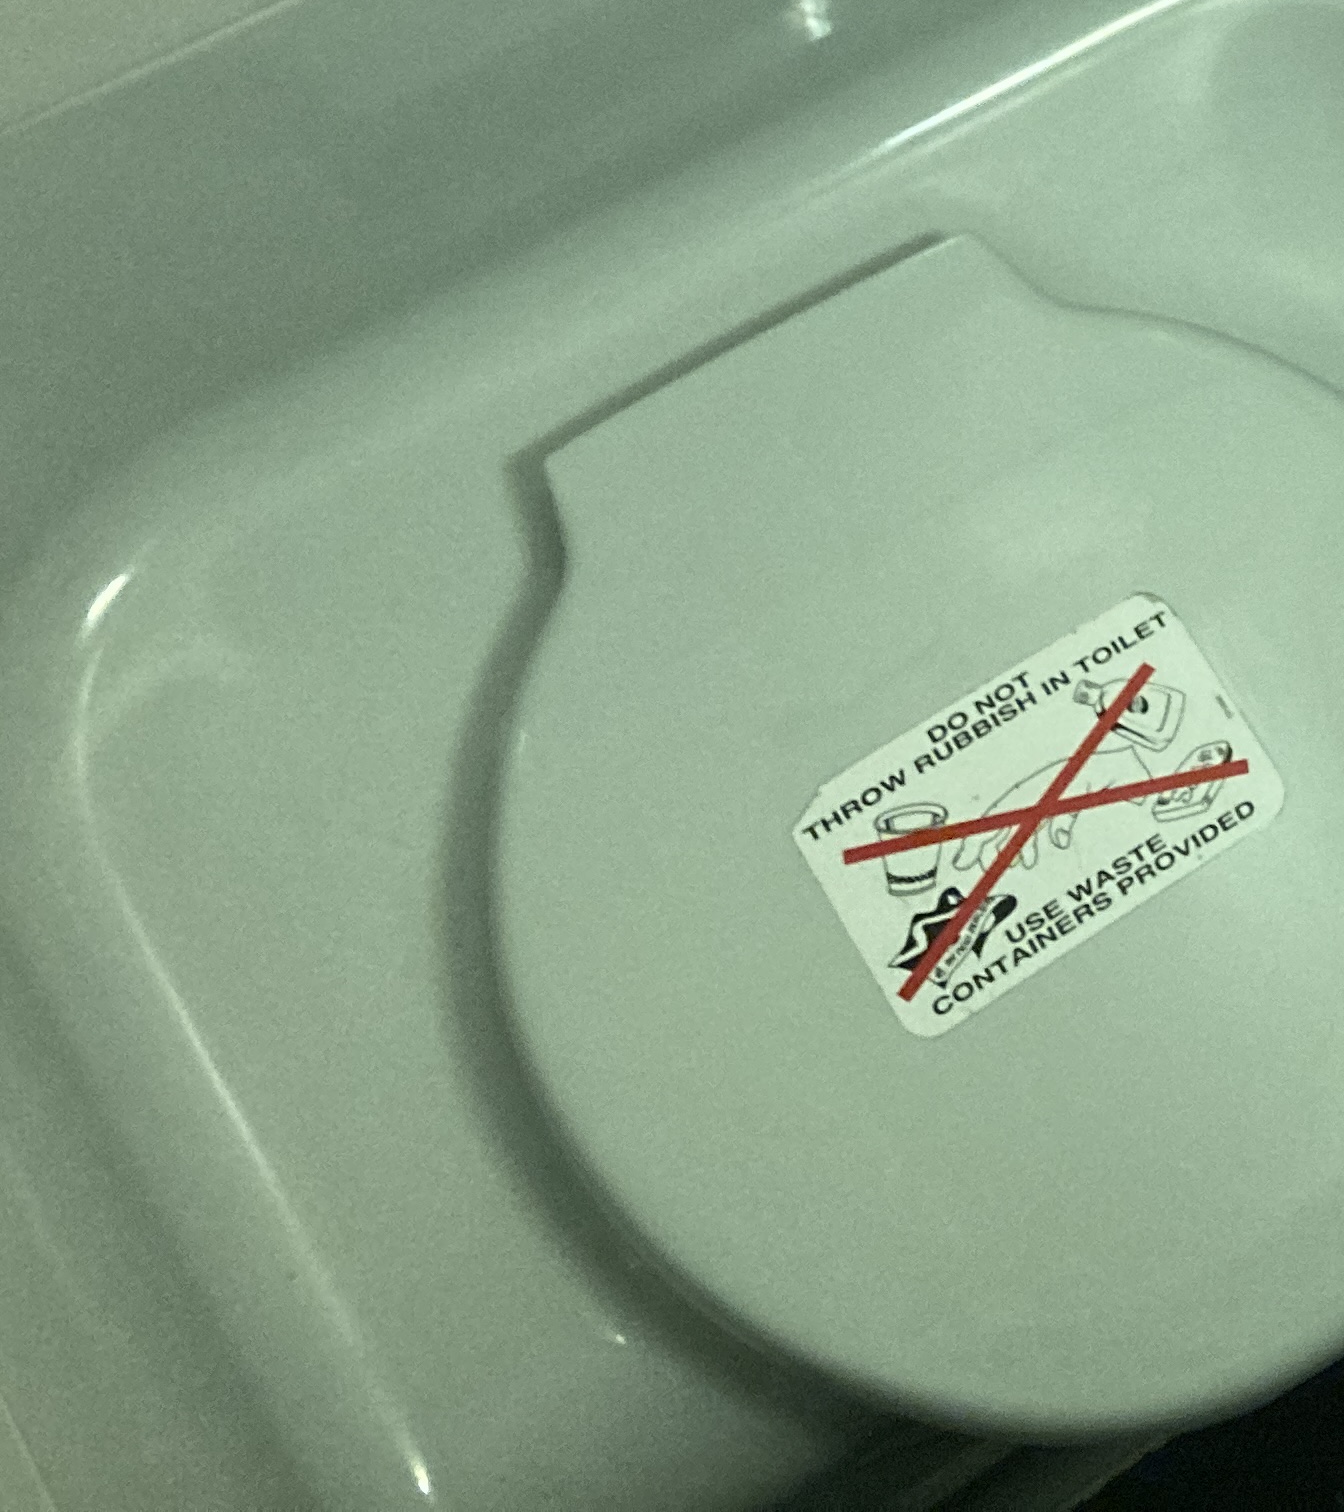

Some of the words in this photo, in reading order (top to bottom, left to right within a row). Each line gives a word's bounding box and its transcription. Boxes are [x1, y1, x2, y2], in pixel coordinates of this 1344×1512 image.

[803, 769, 907, 841] THROW
[914, 693, 1038, 774] RUBBISH
[1042, 669, 1071, 698] IN
[1073, 611, 1169, 674] TOILET
[927, 712, 968, 744] DO
[974, 671, 1030, 717] NOT
[932, 890, 1113, 1015] CONTAINERS
[1121, 799, 1256, 897] PROVIDED
[1005, 899, 1061, 944] USE
[1068, 833, 1168, 900] WASTE
